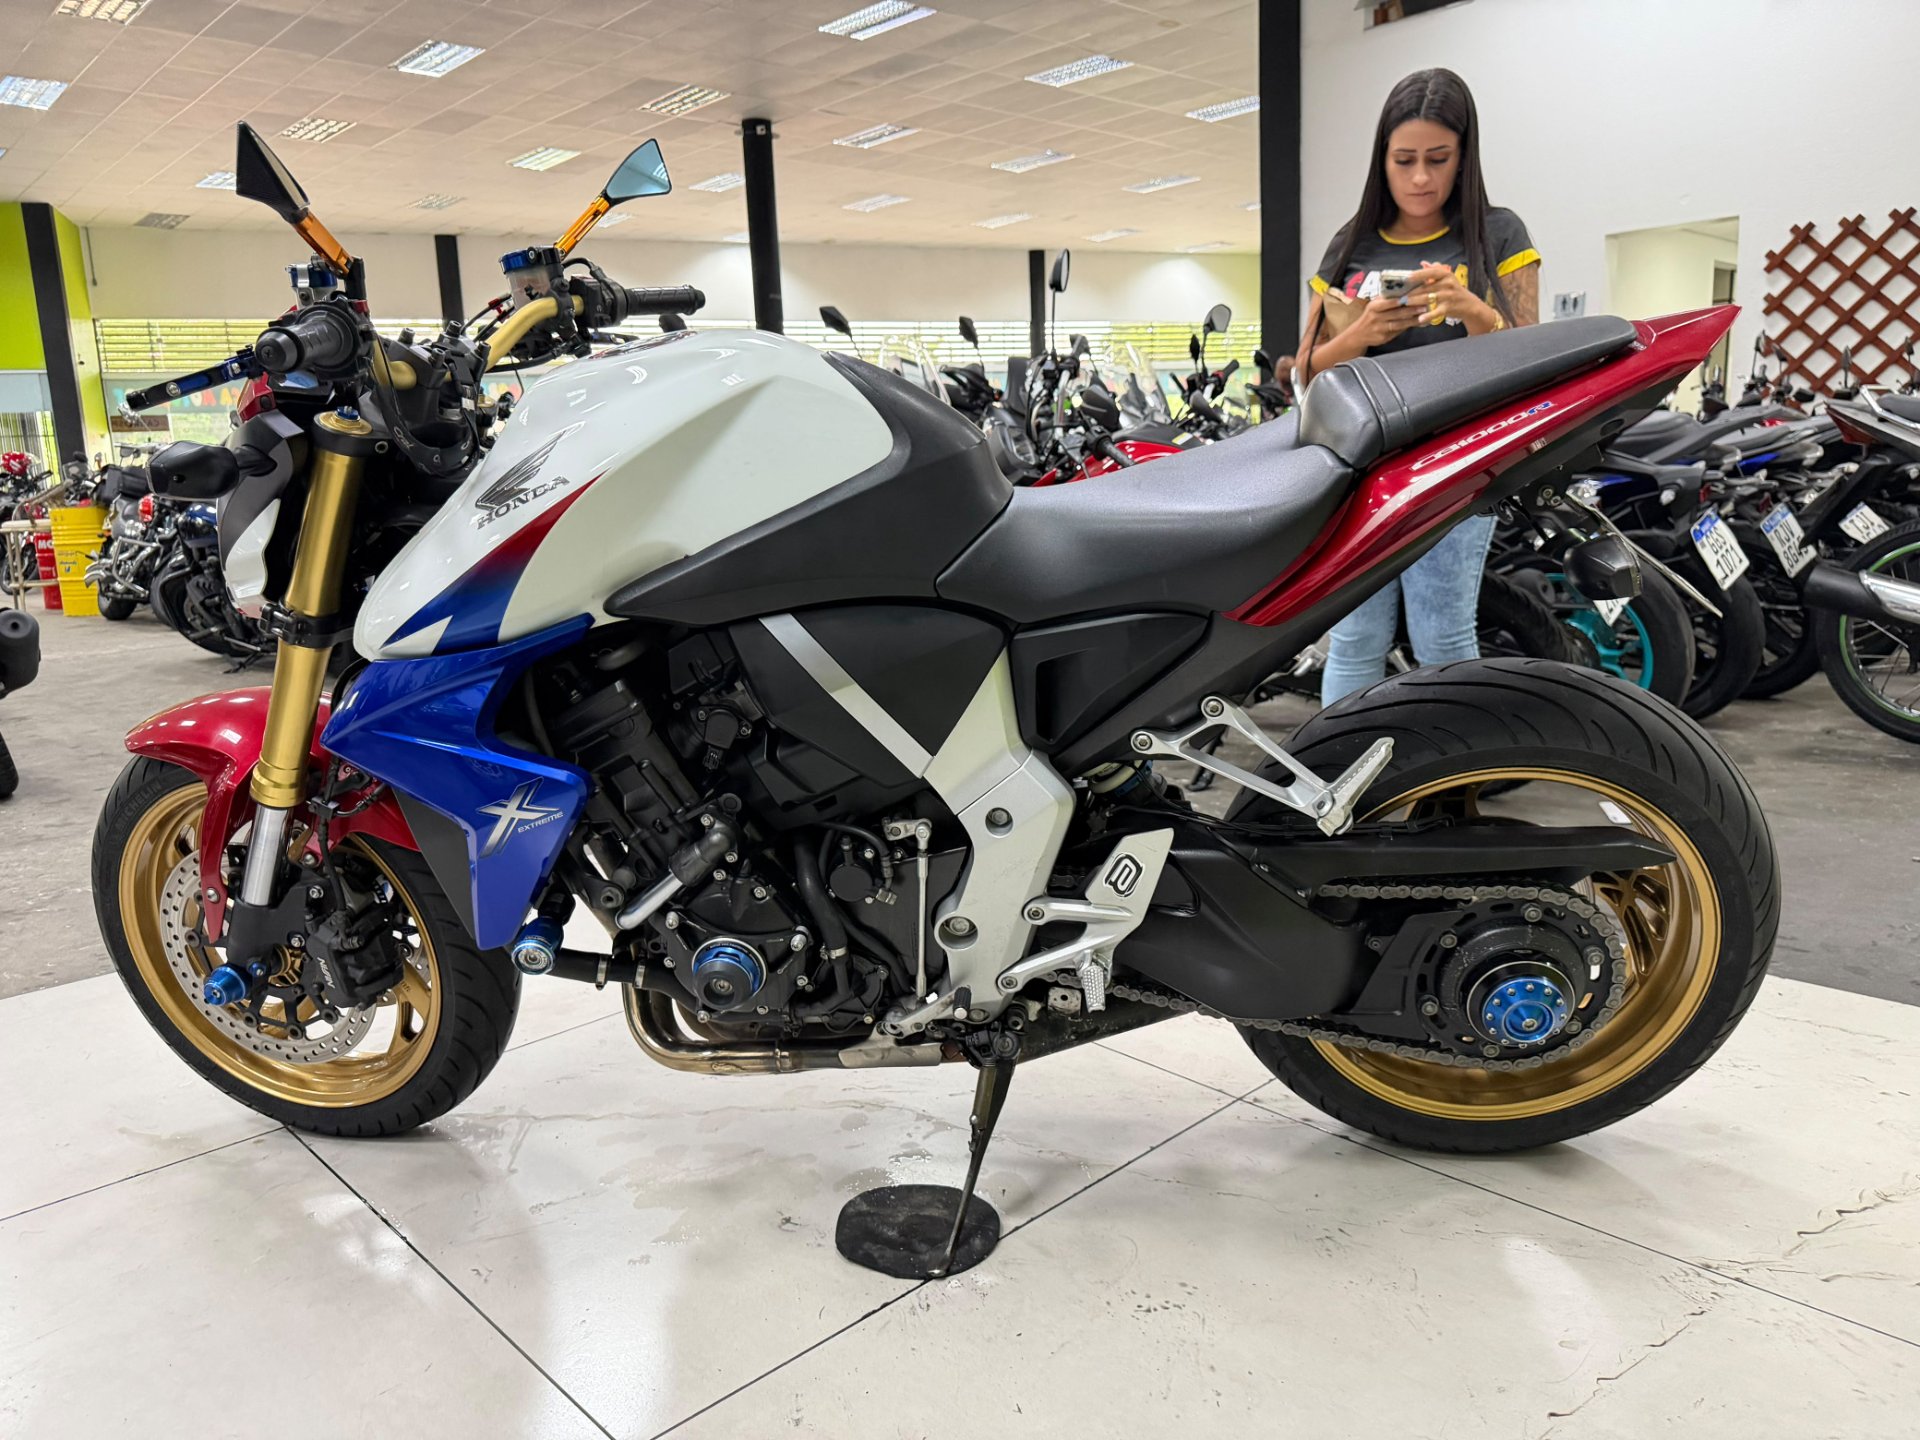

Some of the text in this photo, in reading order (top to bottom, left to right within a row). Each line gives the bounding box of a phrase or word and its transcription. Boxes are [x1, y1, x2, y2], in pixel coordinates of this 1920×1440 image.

[1410, 400, 1554, 471] CB1000R
[477, 475, 570, 530] HONDA
[115, 777, 163, 831] MICHELIN
